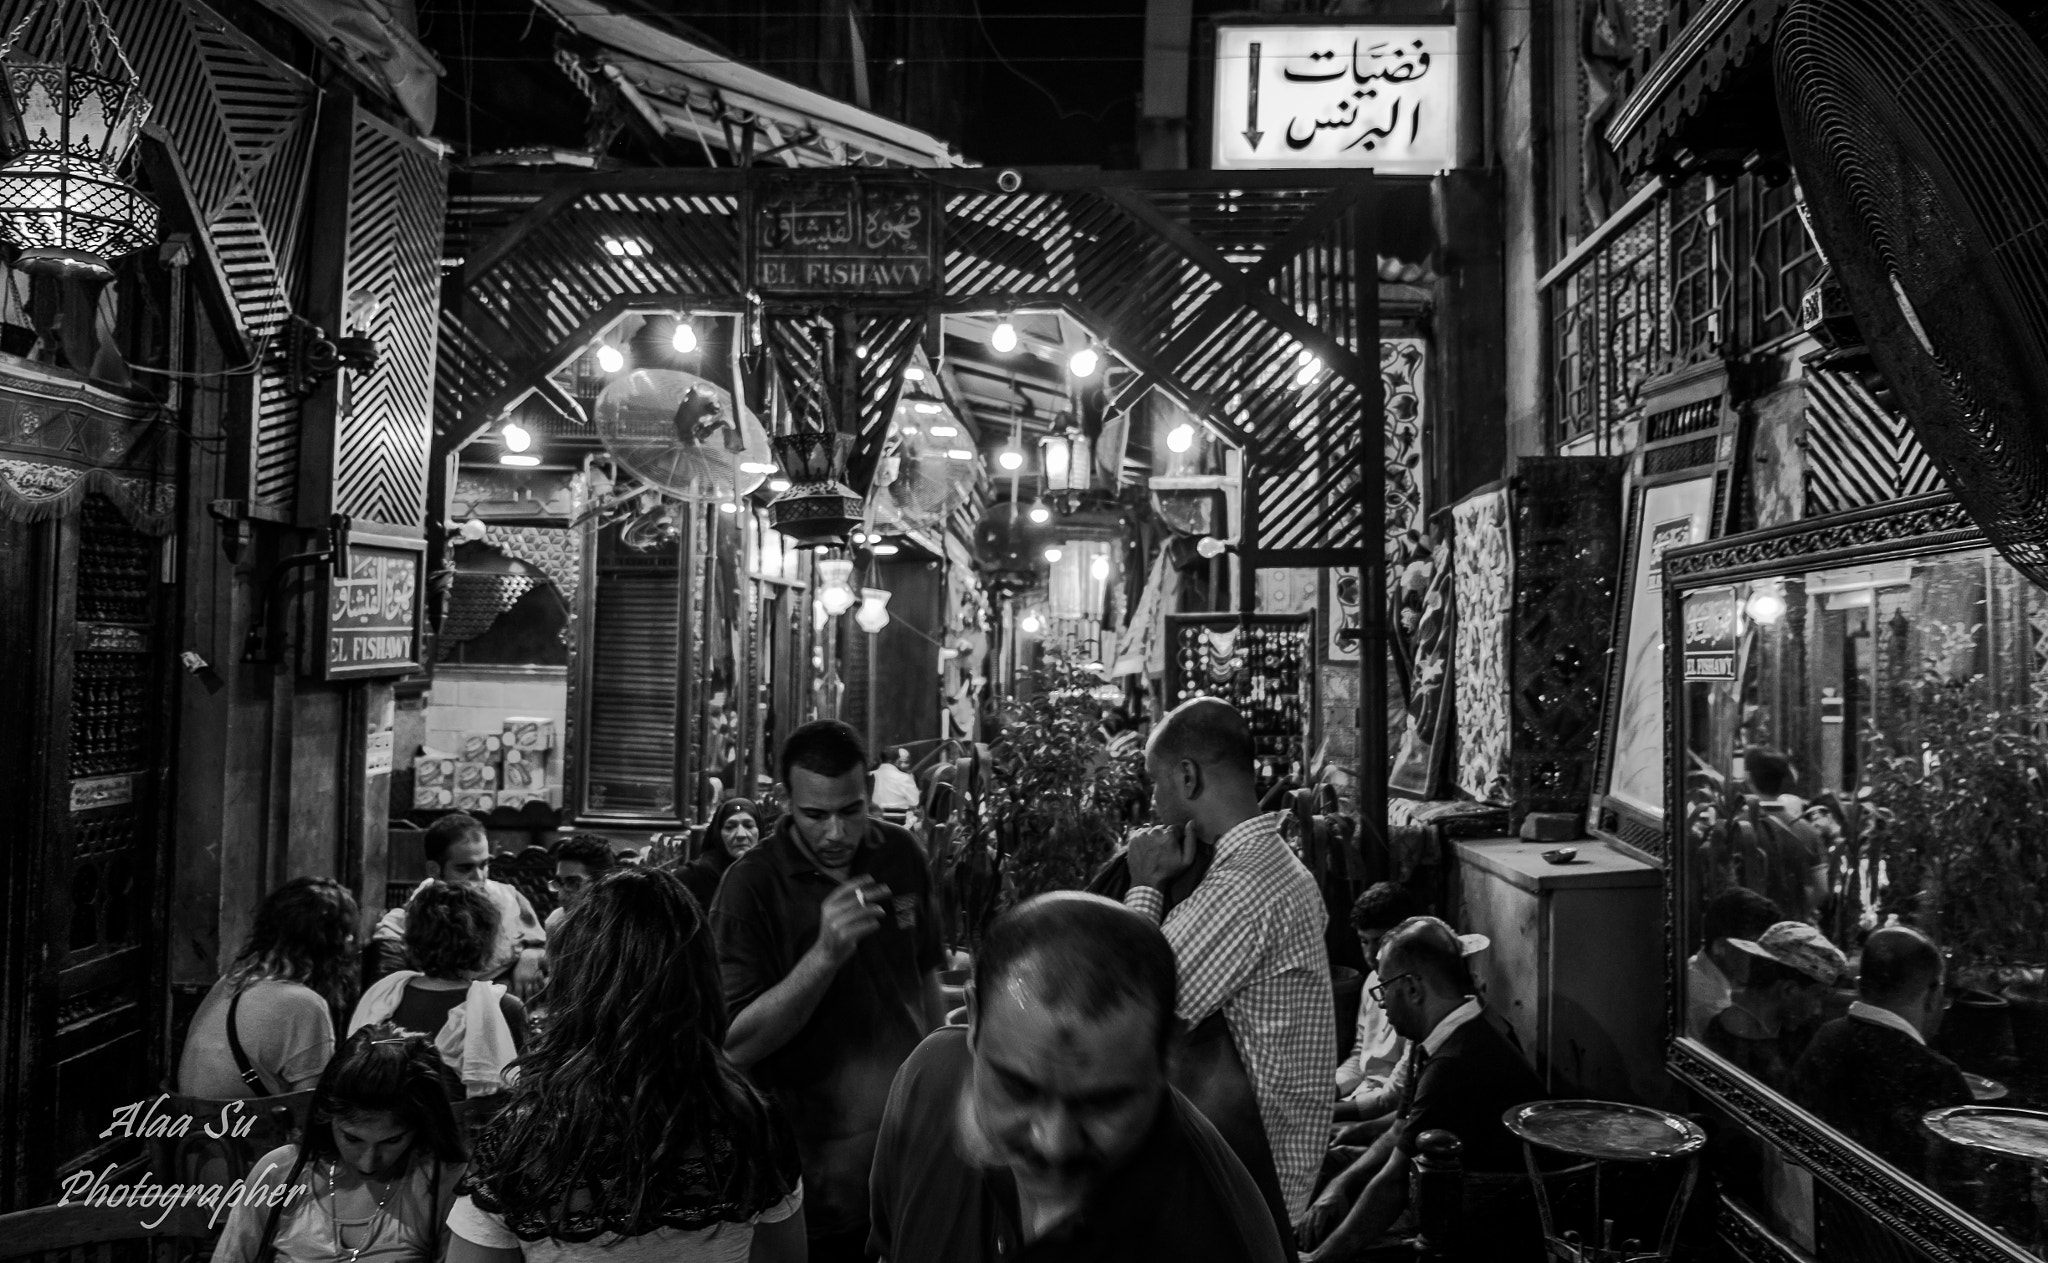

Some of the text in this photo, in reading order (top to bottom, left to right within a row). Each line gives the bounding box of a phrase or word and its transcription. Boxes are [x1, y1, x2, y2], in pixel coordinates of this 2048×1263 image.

[1285, 96, 1421, 152] البرنس
[865, 193, 922, 251] قهوة
[762, 263, 923, 286] EL FISHAWY
[330, 636, 414, 663] EL FISHAWY
